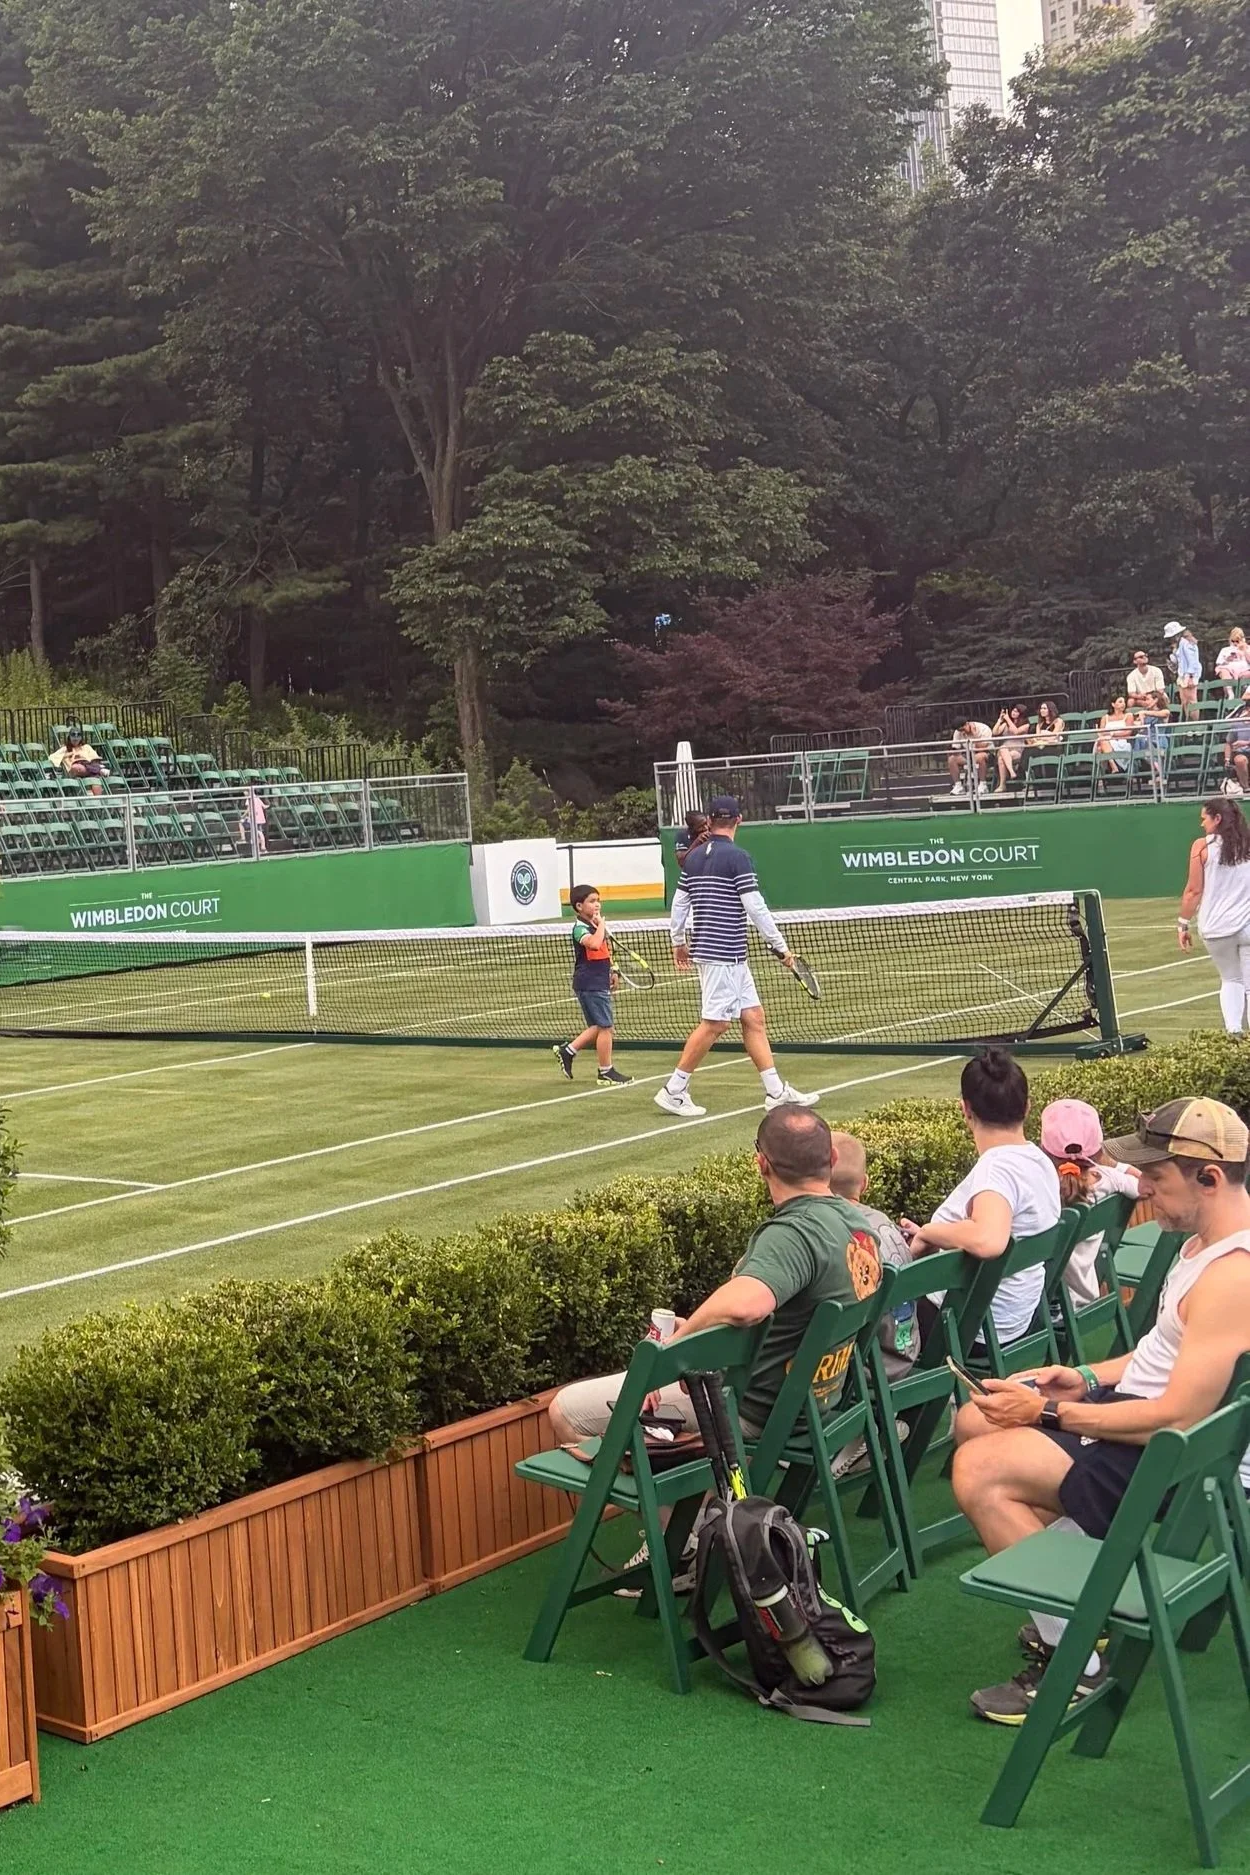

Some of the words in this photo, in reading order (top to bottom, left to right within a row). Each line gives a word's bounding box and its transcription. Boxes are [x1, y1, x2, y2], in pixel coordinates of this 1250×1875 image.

[929, 837, 944, 845] THE
[842, 848, 965, 868] WIMBLEDON
[969, 845, 1040, 863] COURT
[887, 876, 923, 884] CENTRAL
[925, 876, 949, 884] PARK,
[141, 892, 153, 900] THE
[70, 903, 167, 929] WIMBLEDON
[170, 898, 220, 918] COURT
